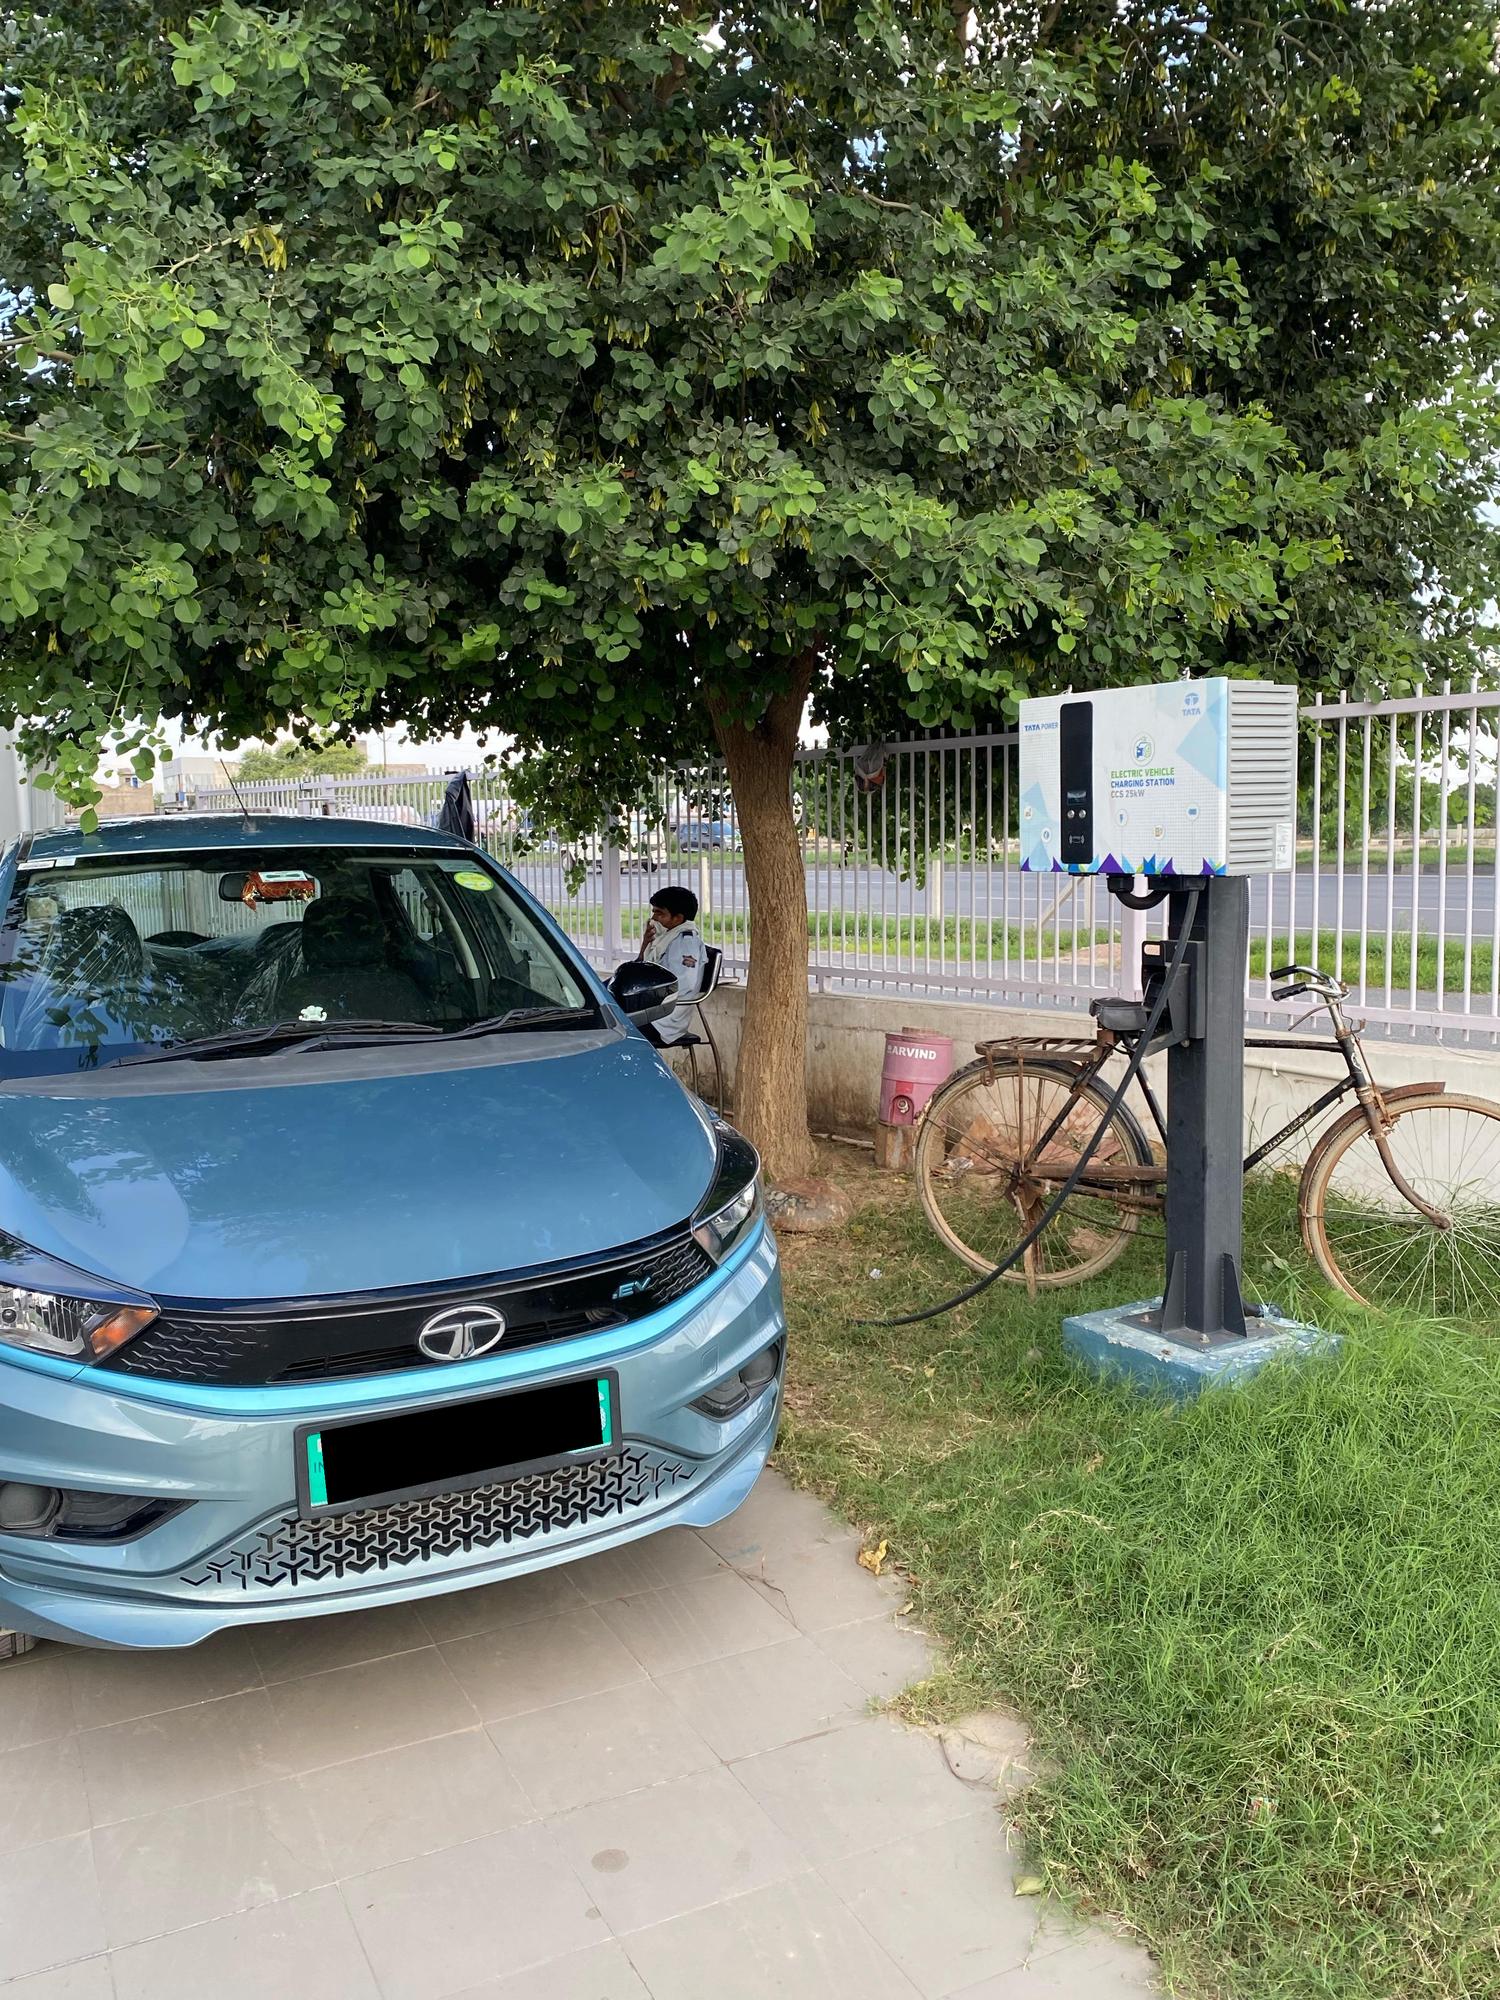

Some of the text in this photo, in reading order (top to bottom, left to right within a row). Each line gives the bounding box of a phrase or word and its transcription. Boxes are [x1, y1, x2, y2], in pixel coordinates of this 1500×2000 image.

[1182, 707, 1201, 716] TATA
[1024, 721, 1059, 731] TATA POWER
[1110, 767, 1175, 779] ELECTRIC VEHICLE
[1110, 777, 1175, 789] CHARGING STATION
[1110, 789, 1145, 798] CCS 25kW
[892, 1045, 937, 1060] ARVIND
